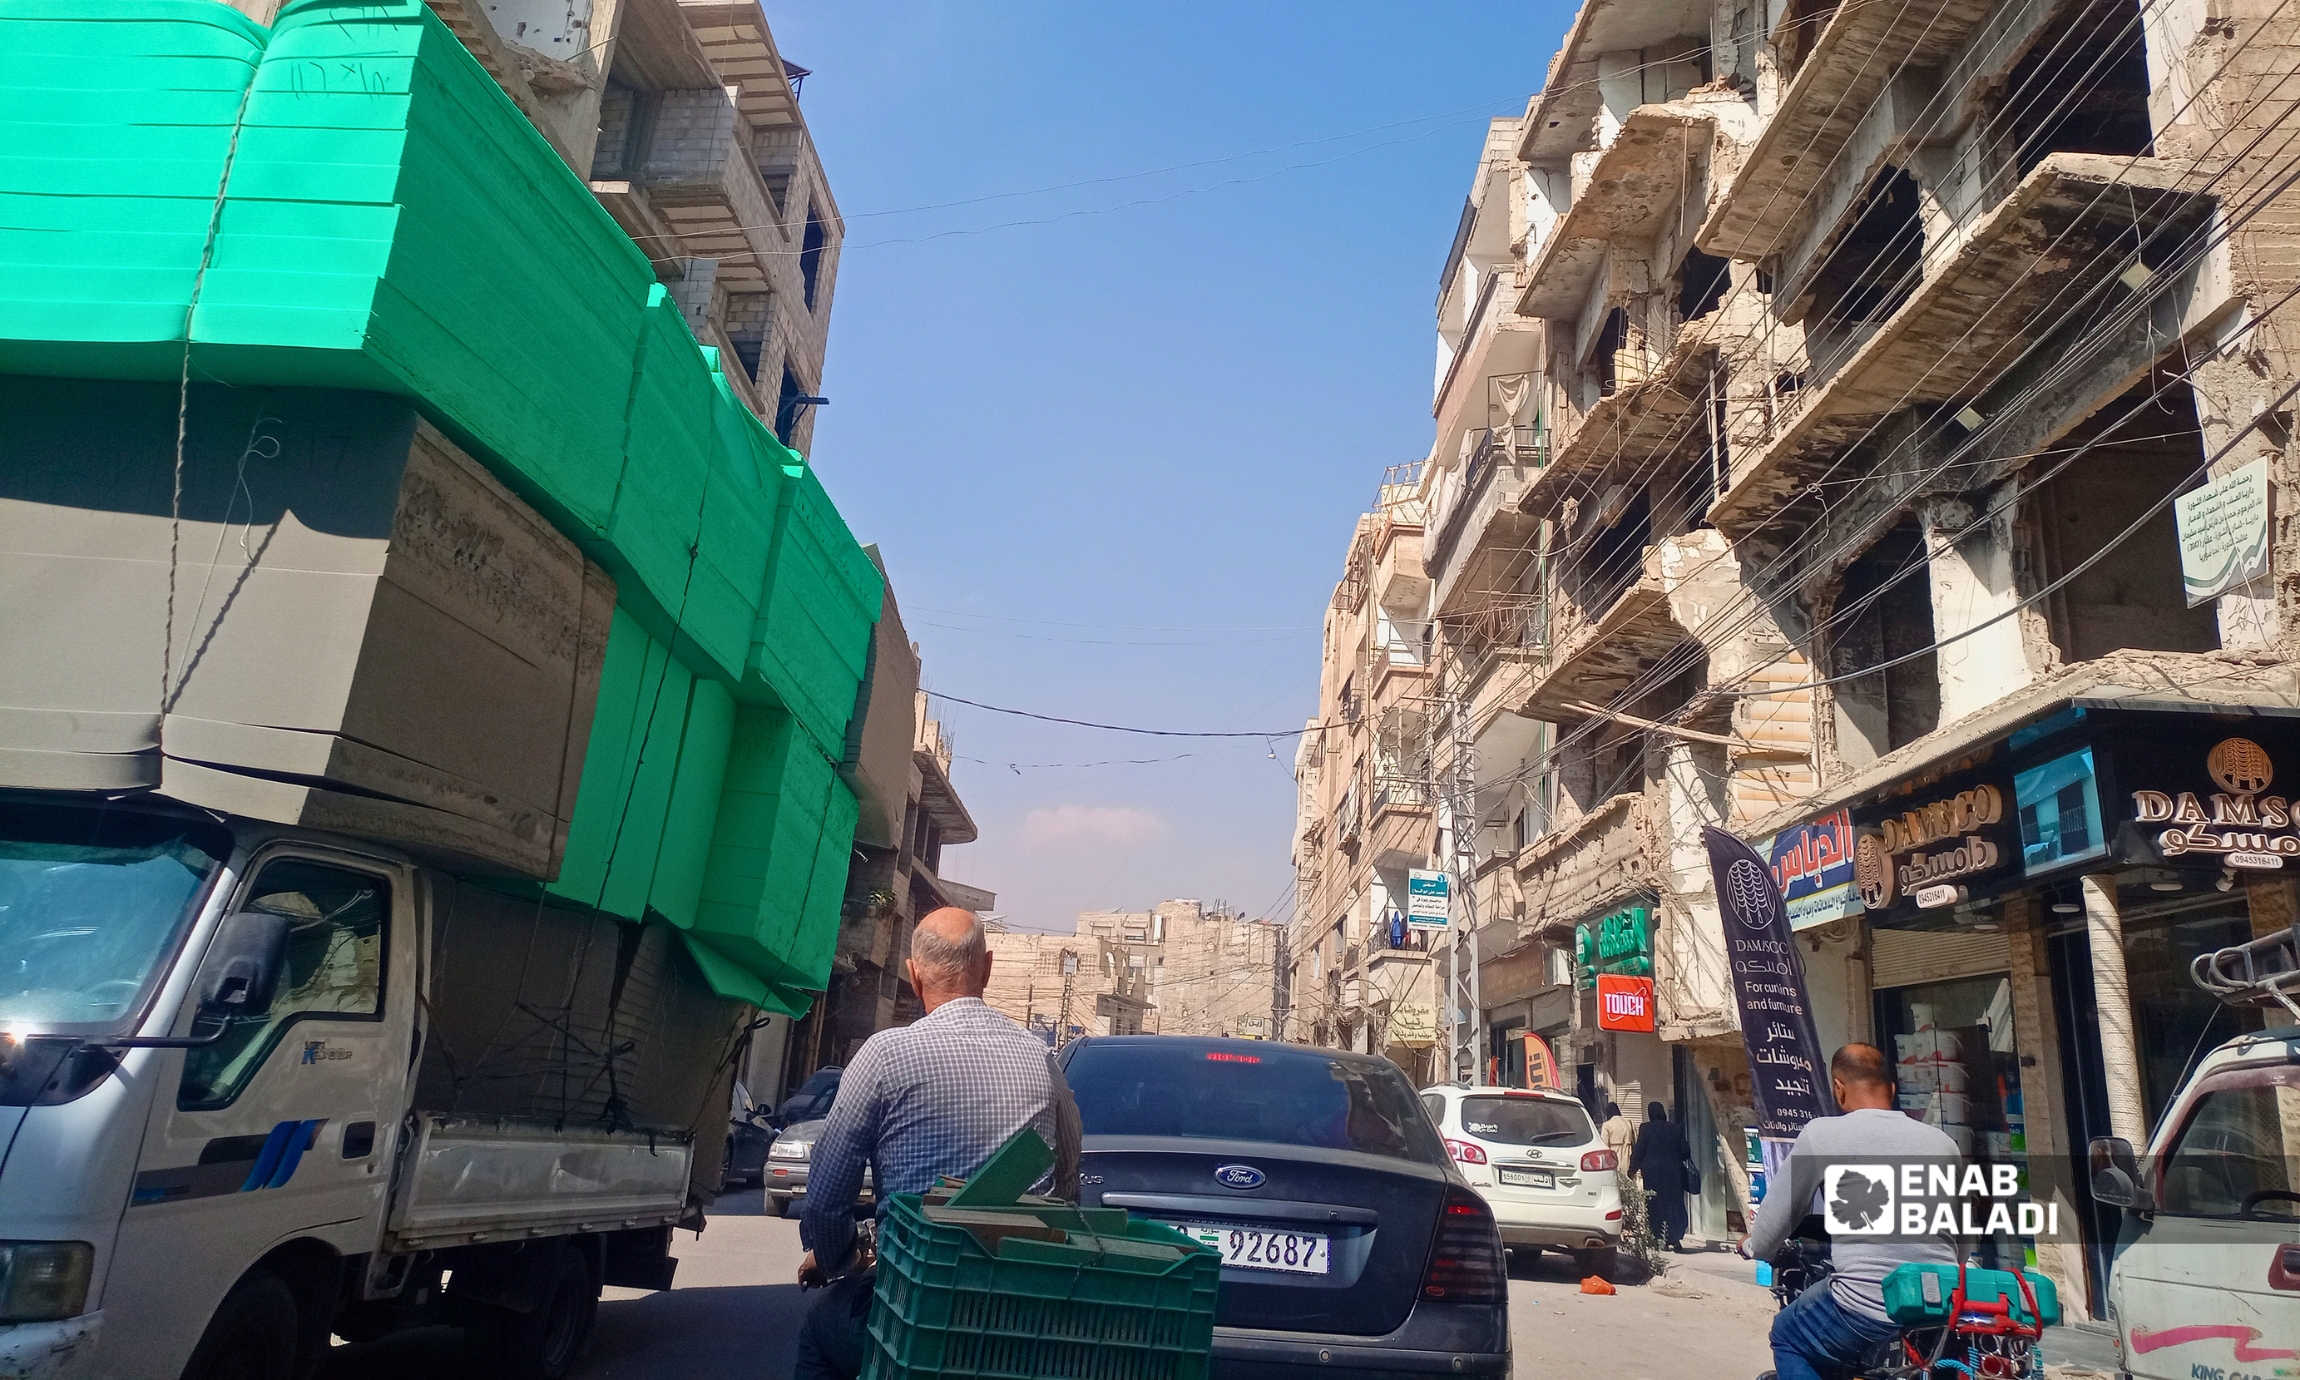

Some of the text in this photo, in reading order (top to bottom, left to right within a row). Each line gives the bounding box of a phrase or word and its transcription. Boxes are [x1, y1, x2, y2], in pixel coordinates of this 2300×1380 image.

[1881, 784, 2002, 855] DAMSCO
[1900, 836, 1998, 896] دامسكو
[2234, 855, 2280, 867] 0945316411
[1744, 980, 1763, 993] For
[1604, 992, 1645, 1017] TOUCH
[1747, 998, 1767, 1010] and
[1766, 1021, 1797, 1043] ستائر
[1776, 1107, 1798, 1118] 0945
[1227, 1169, 1253, 1184] Ford
[1229, 1229, 1317, 1268] 92687
